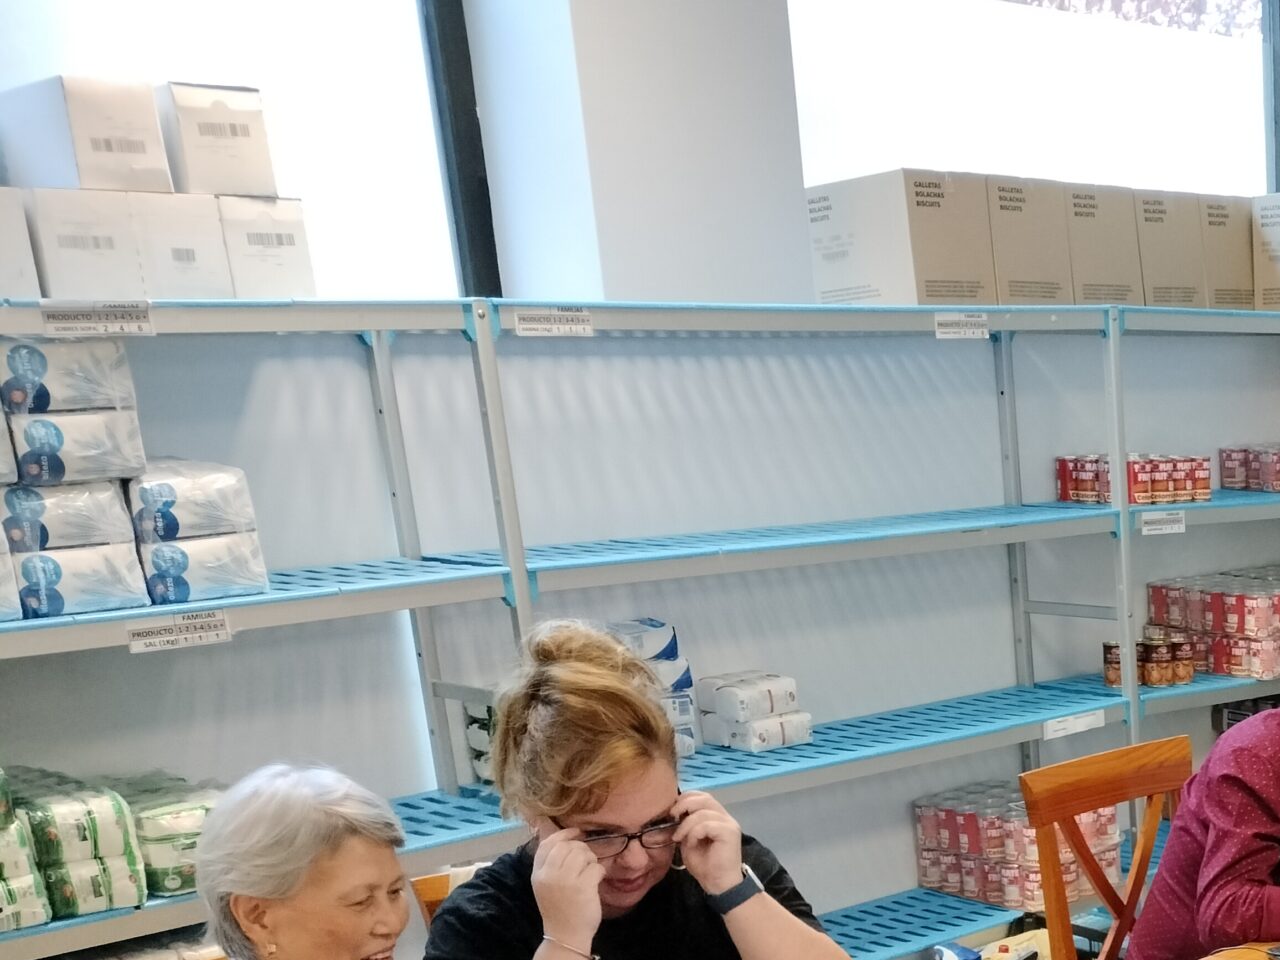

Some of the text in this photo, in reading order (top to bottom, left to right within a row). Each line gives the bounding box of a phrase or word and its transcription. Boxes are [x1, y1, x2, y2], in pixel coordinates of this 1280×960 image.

[914, 181, 942, 189] GALLETAS
[997, 186, 1023, 194] GALLETAS
[915, 190, 945, 199] BOLACHAS
[1072, 193, 1096, 201] GALLETAS
[998, 195, 1026, 204] BOLACHAS
[916, 200, 941, 208] BISCUITS
[1000, 204, 1022, 212] BISCUITS
[182, 612, 216, 621] FAMILIAS
[132, 628, 174, 638] PRODUCTO
